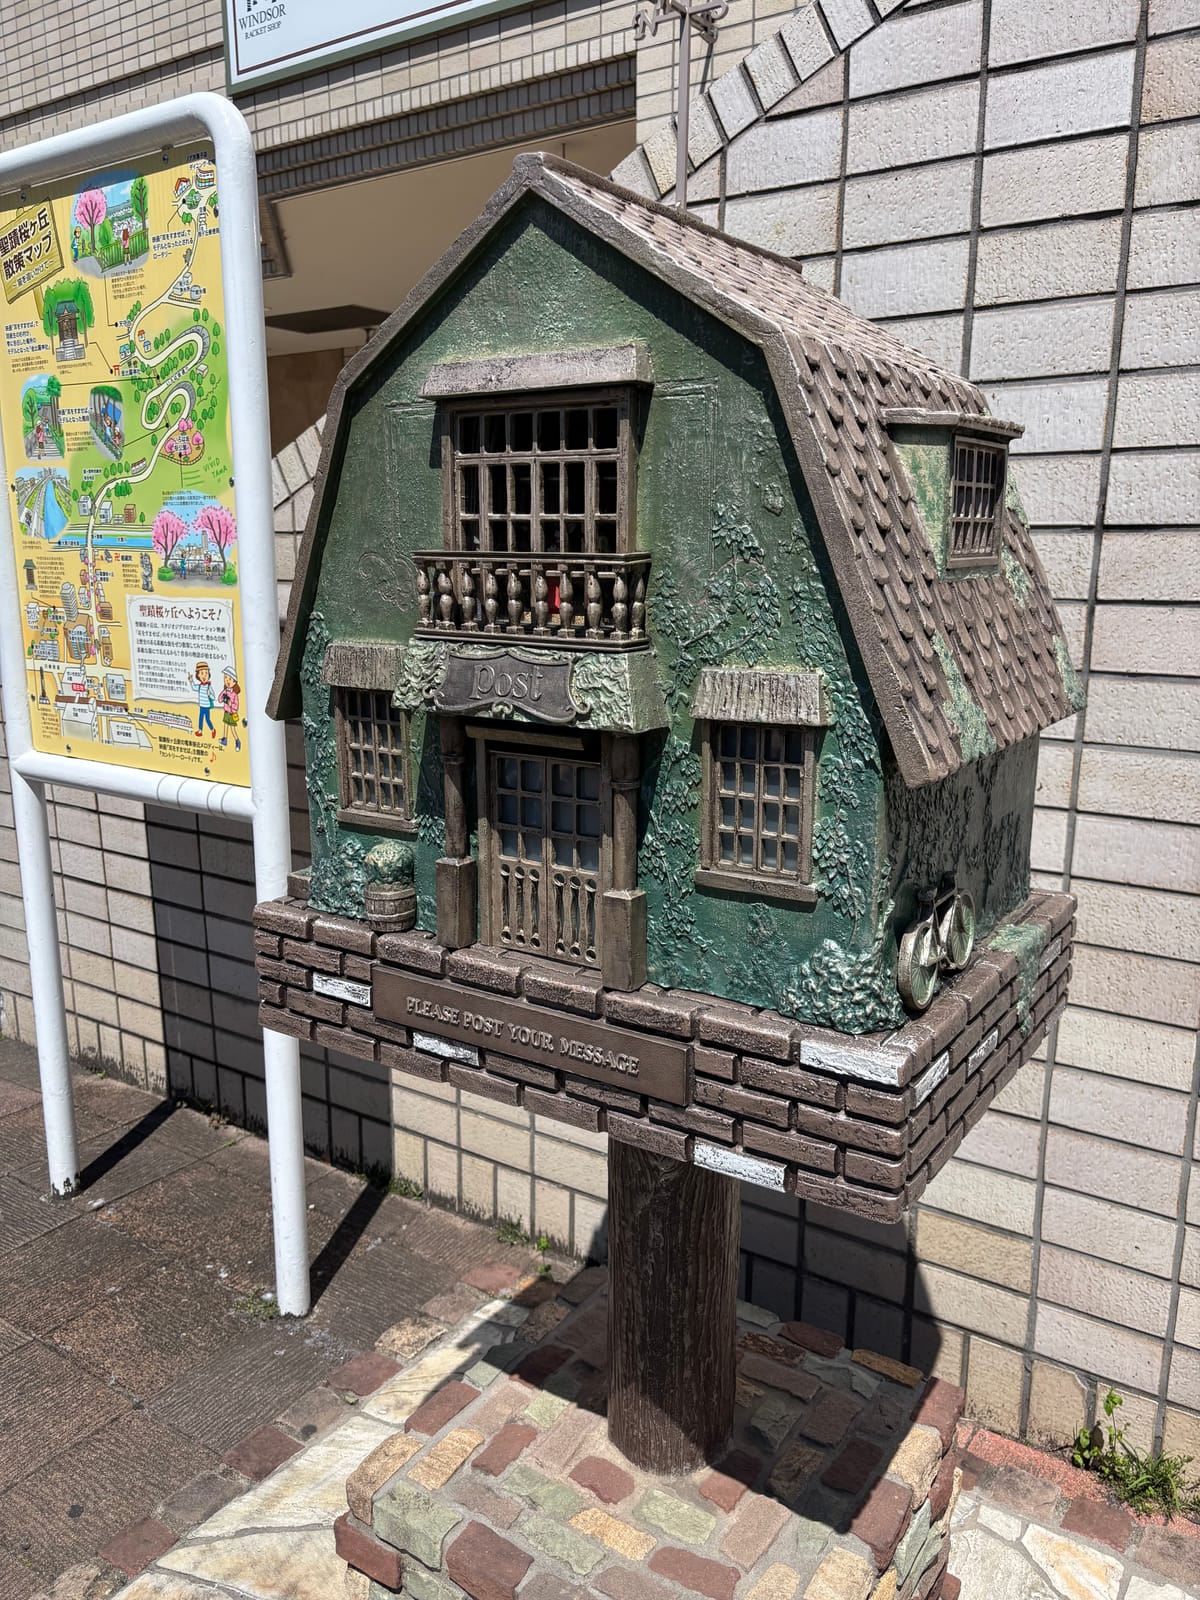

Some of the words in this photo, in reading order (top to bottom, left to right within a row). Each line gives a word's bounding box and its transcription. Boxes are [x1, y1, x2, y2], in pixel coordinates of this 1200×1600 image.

[239, 4, 286, 30] WINDSOR
[245, 26, 266, 39] RACKET
[268, 21, 281, 32] SHOP
[0, 208, 49, 256] 聖蹟桜ヶ丘
[3, 231, 51, 280] 散策マップ
[469, 664, 544, 701] Post
[406, 996, 461, 1026] PLEASE
[463, 1010, 505, 1037] POST
[507, 1022, 554, 1051] YOUR
[559, 1036, 640, 1078] MESSAGE
